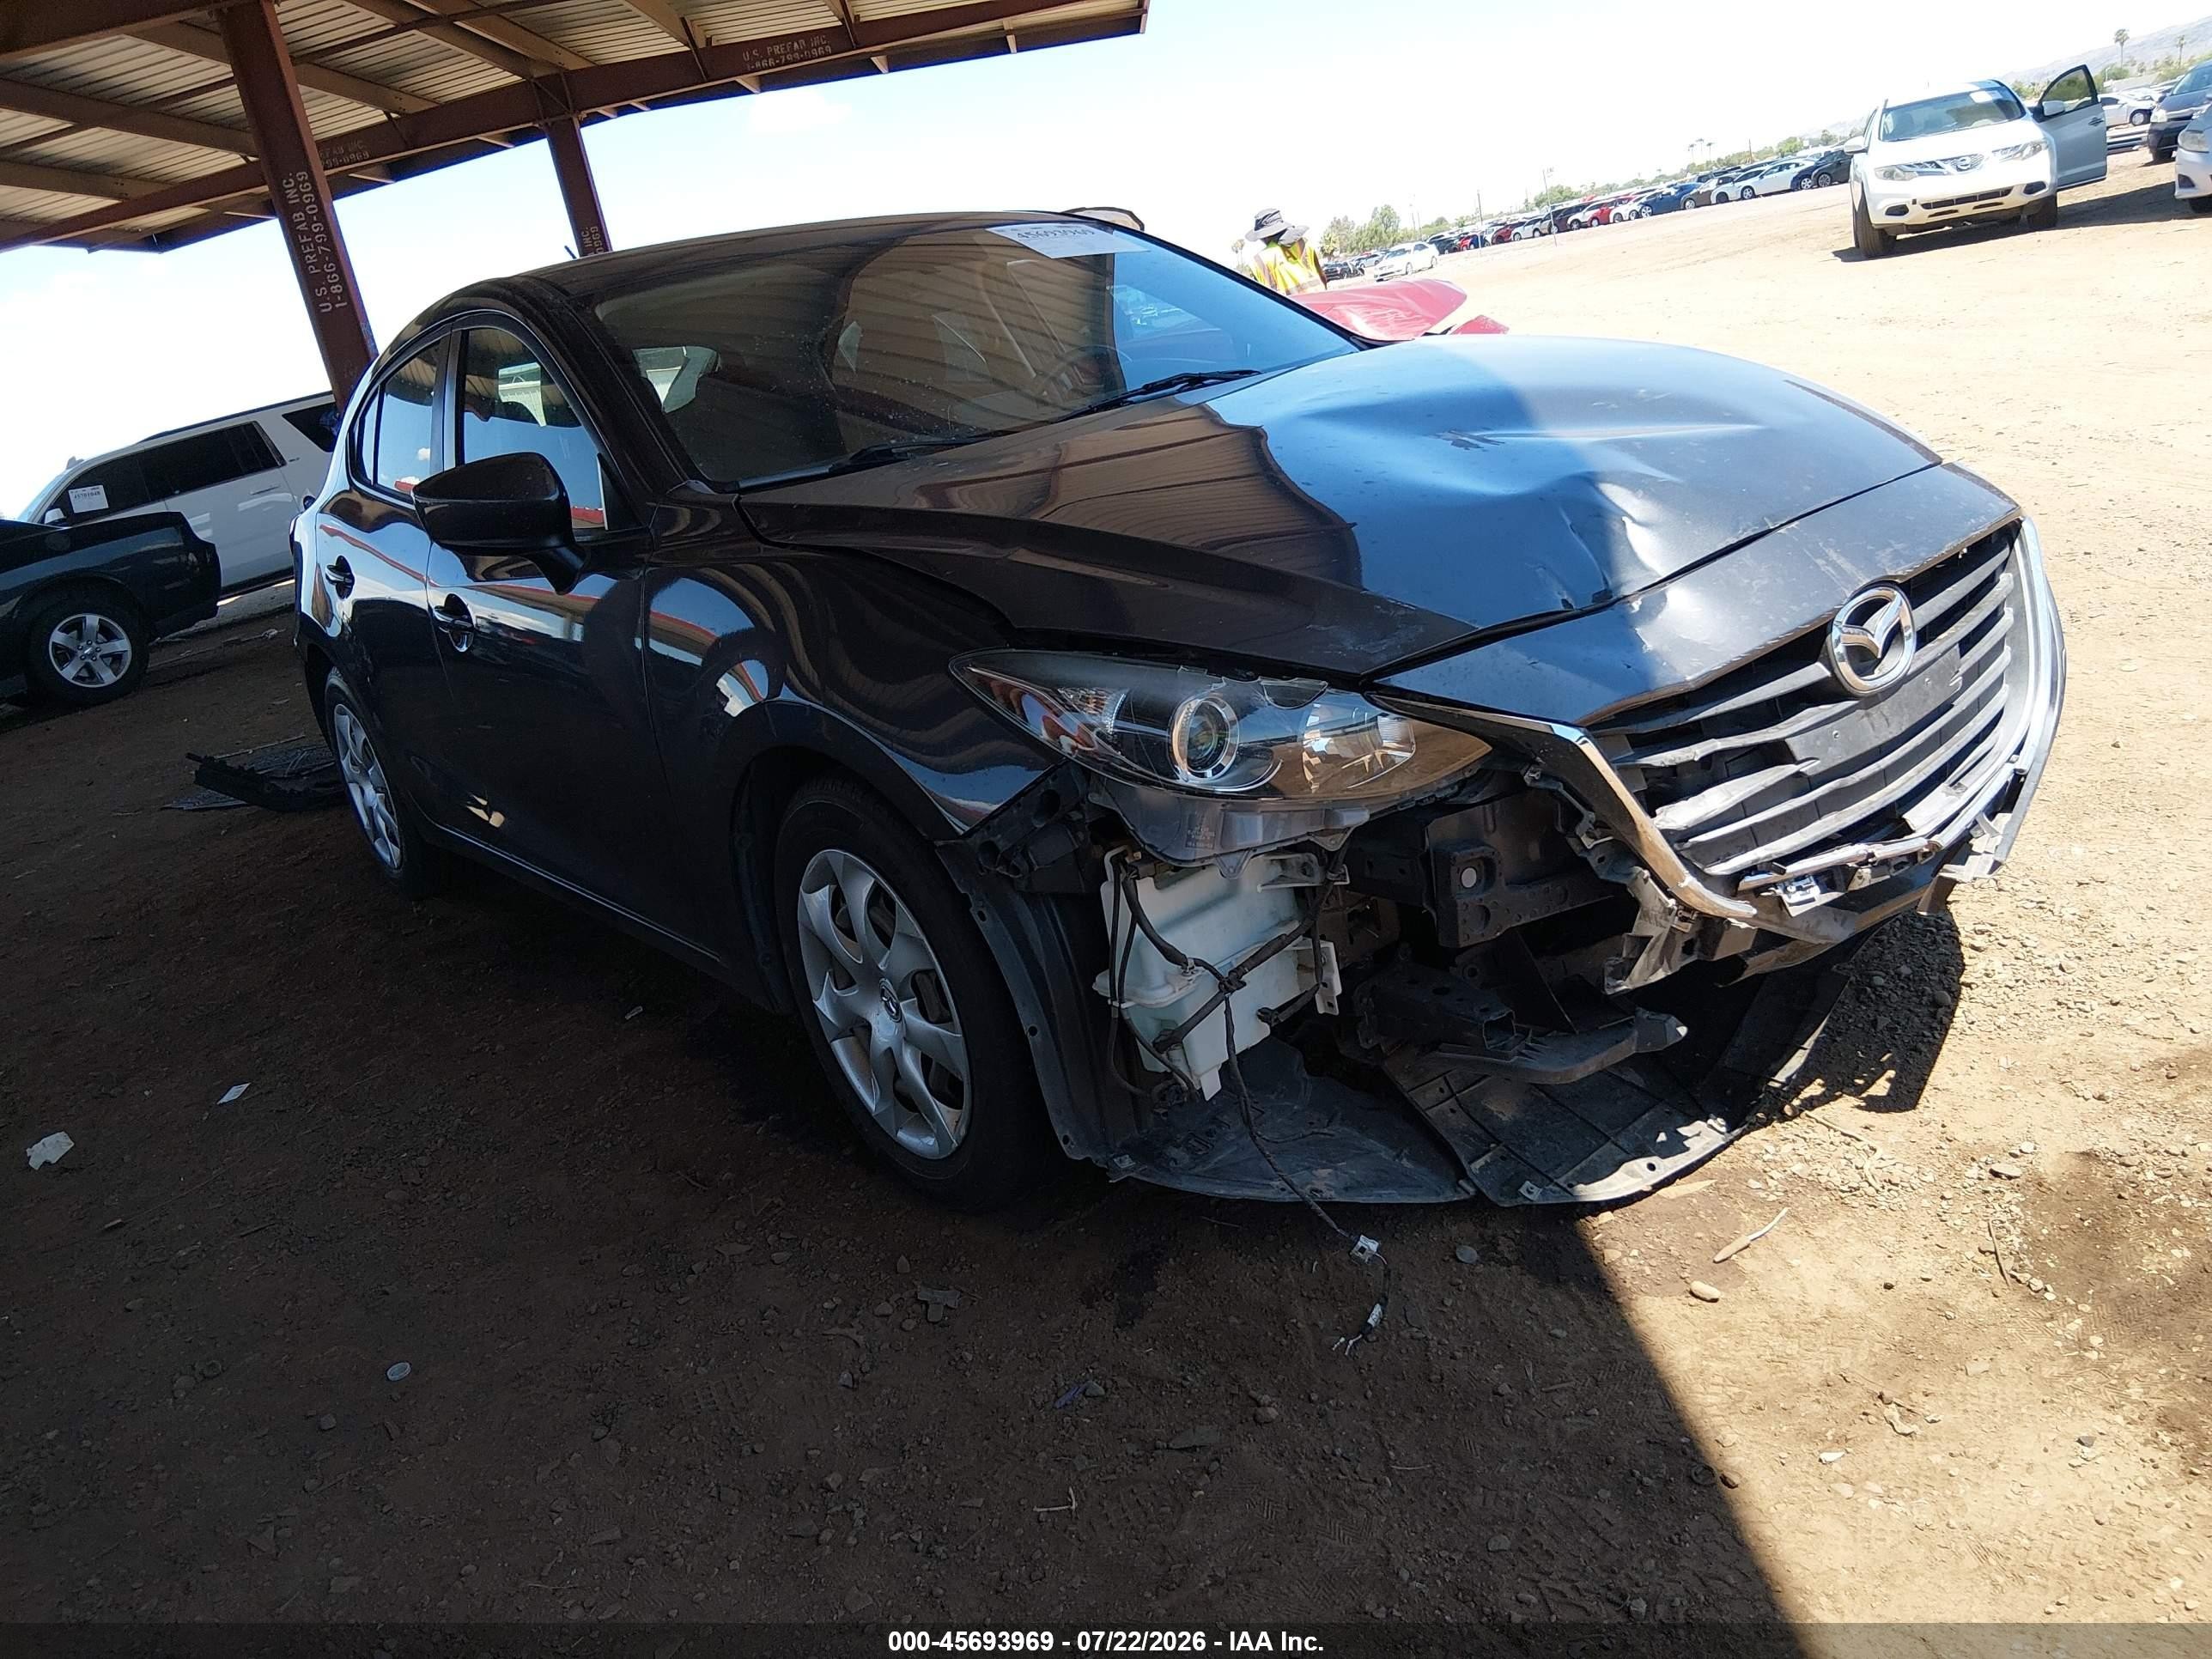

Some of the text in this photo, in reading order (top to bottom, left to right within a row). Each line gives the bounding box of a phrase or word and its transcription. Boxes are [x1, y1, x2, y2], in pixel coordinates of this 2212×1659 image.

[283, 173, 333, 313] U.S. PREFAB INC.
[295, 171, 348, 307] 1-866-799-0969
